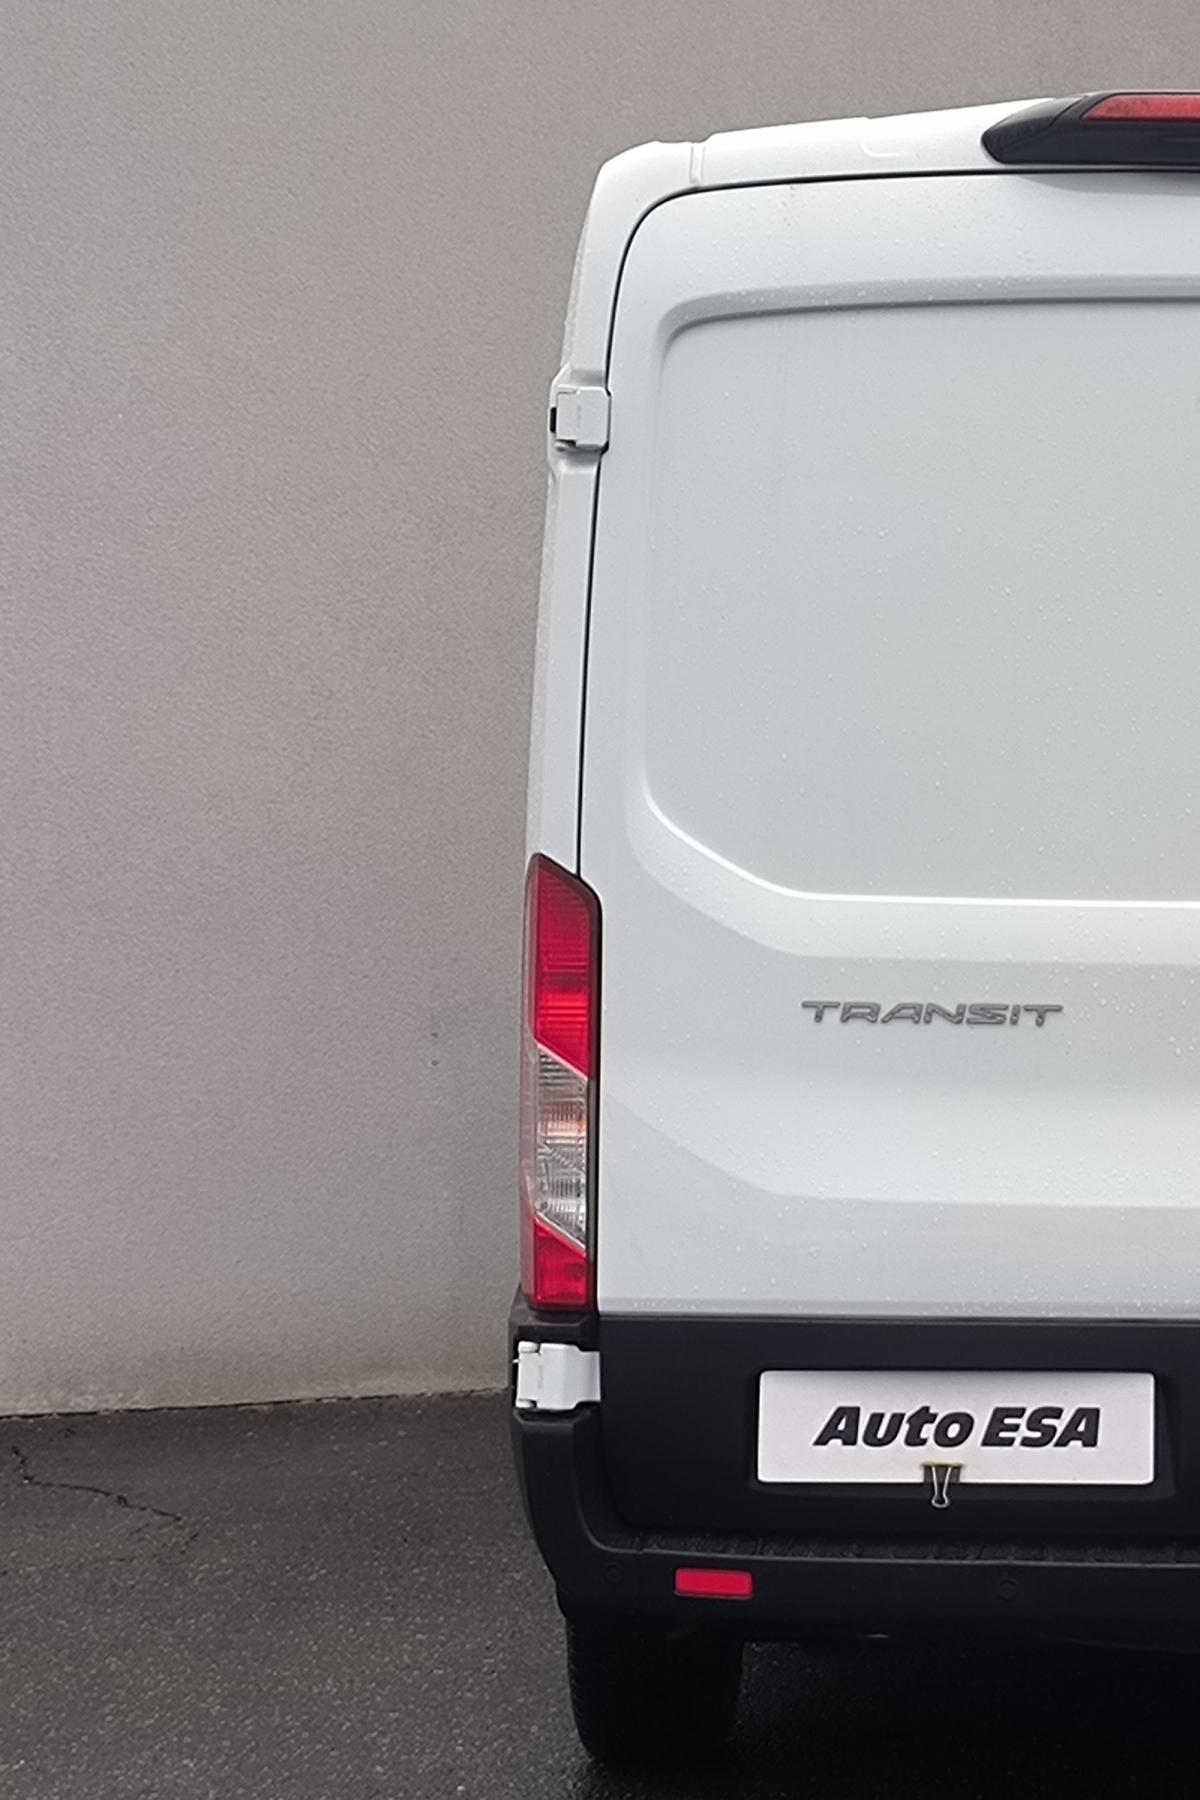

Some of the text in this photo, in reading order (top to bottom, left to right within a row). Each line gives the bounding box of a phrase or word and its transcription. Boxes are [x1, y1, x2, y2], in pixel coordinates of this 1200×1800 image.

[801, 1001, 1063, 1026] TRANSIT
[813, 1406, 1100, 1447] Auto ESA
